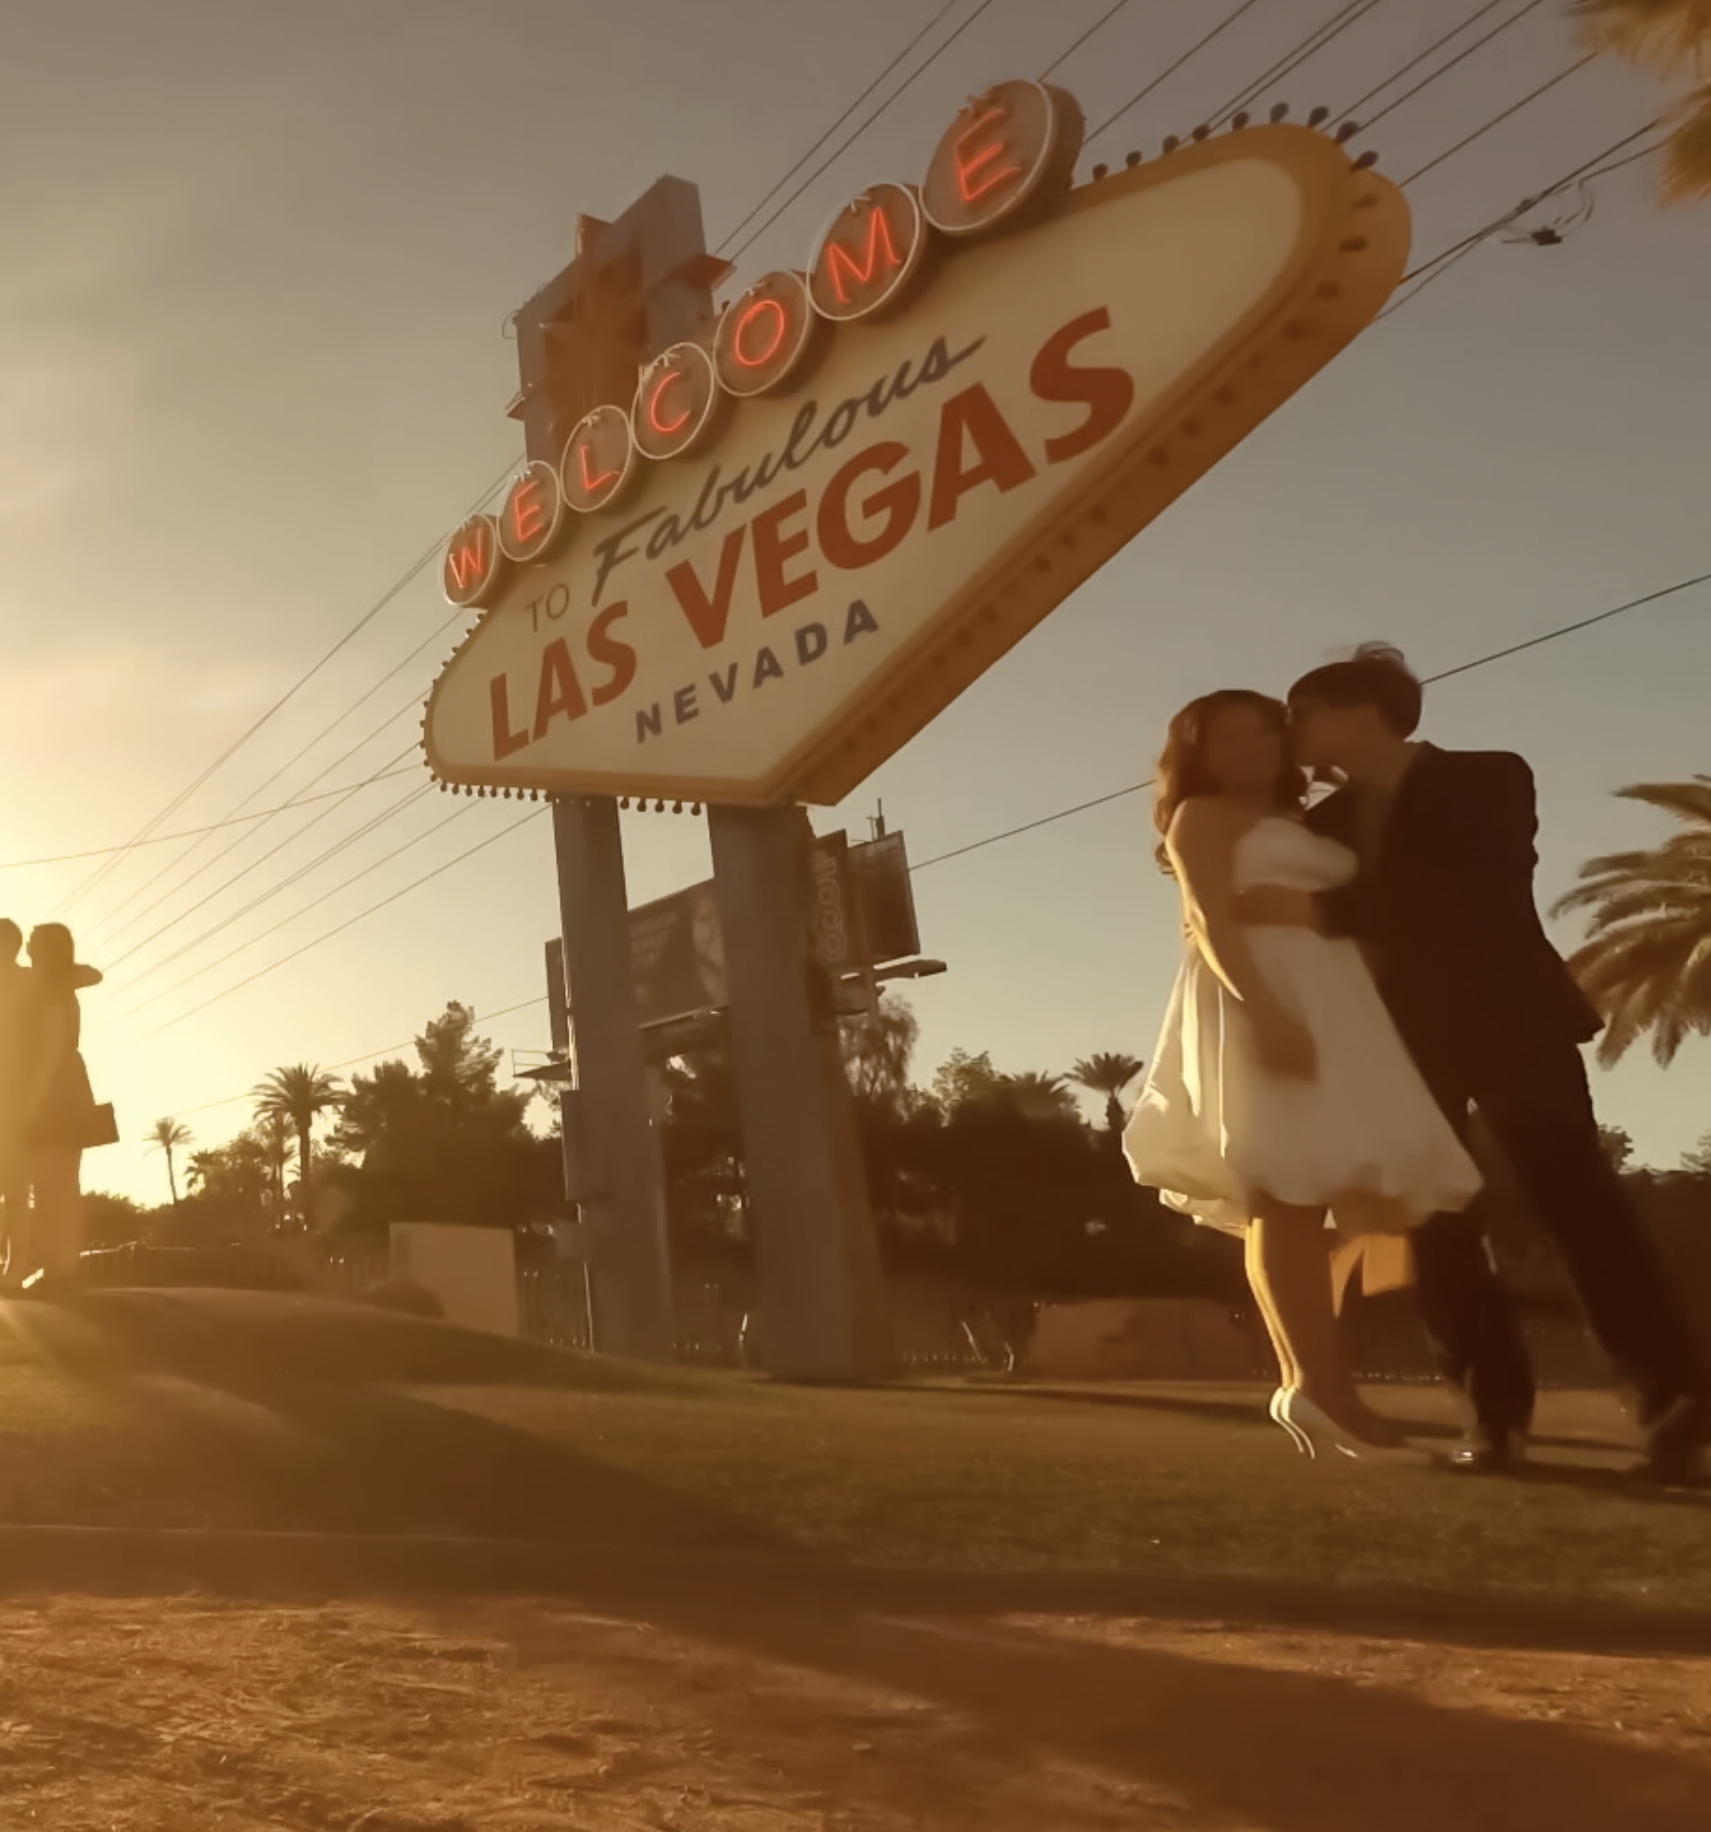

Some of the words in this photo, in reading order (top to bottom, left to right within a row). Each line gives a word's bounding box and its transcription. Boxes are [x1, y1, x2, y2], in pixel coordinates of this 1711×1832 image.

[448, 106, 1025, 590] WELCOME
[489, 600, 637, 762] LAS
[664, 304, 1136, 651] VEGAS
[524, 582, 571, 633] TO
[591, 335, 987, 607] Fabulous
[635, 598, 880, 745] NEVADA
